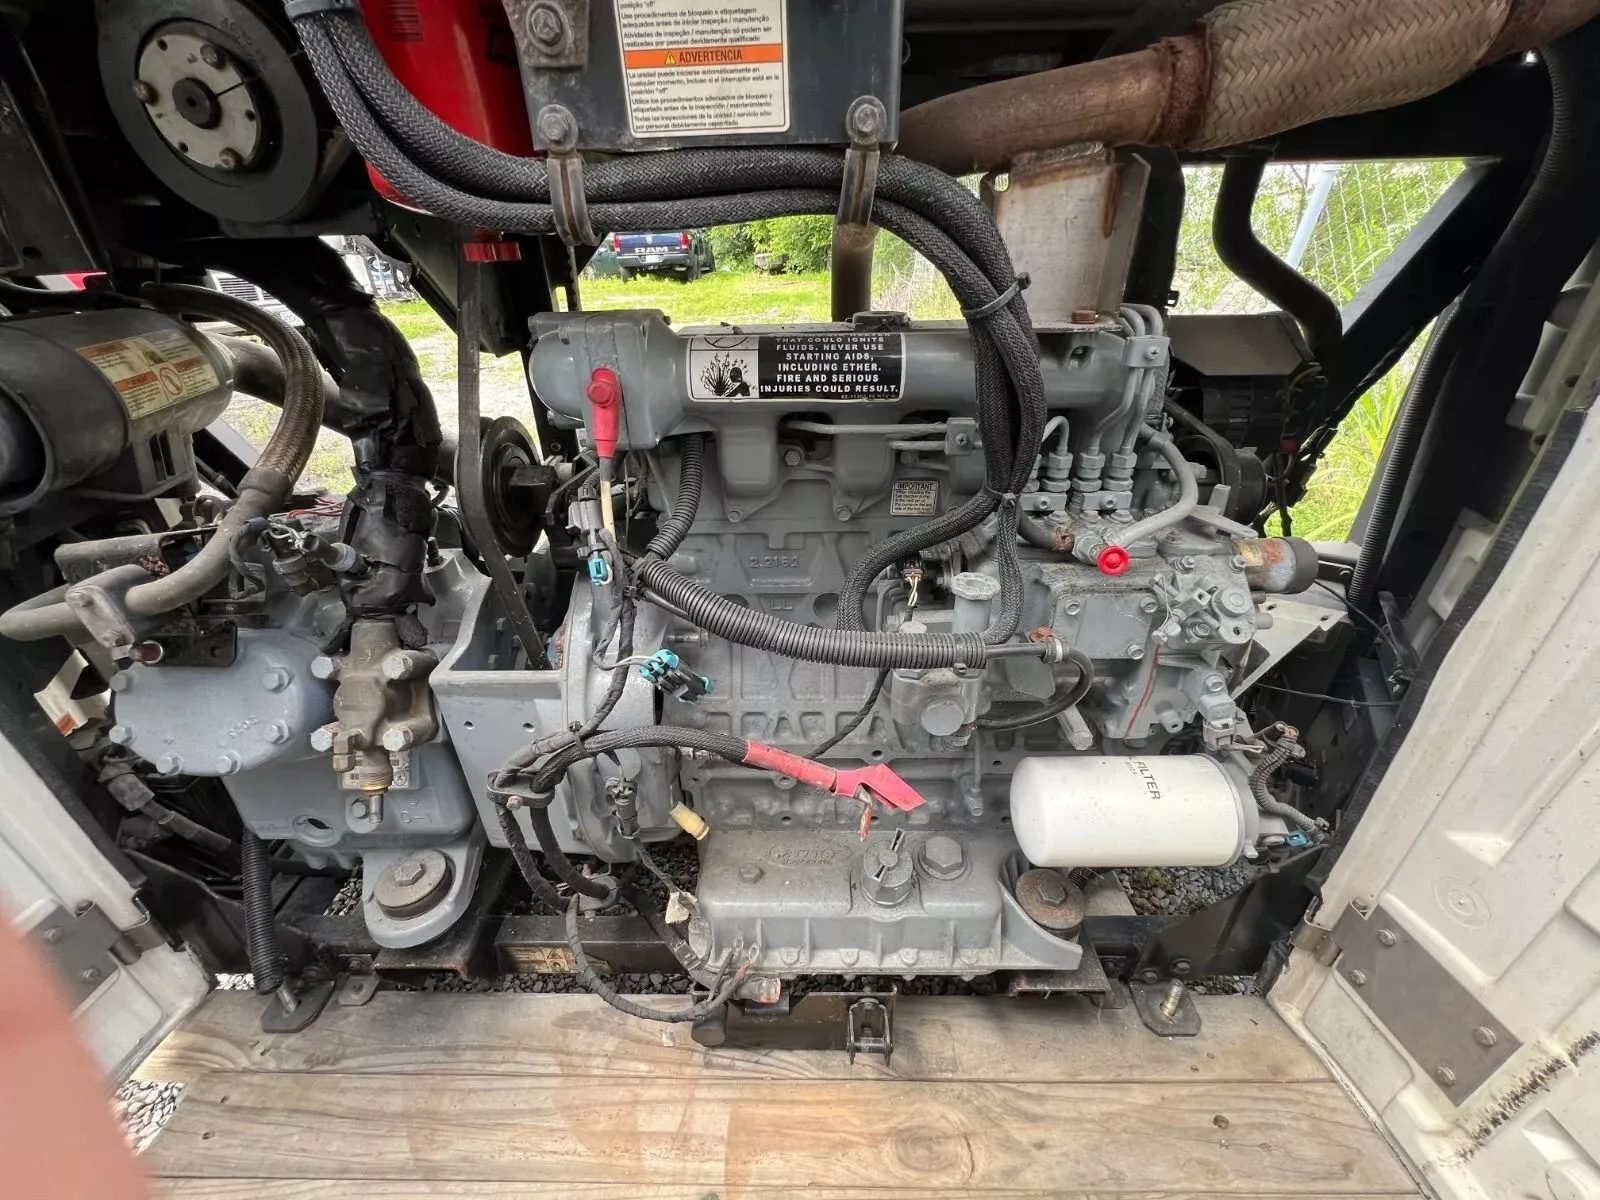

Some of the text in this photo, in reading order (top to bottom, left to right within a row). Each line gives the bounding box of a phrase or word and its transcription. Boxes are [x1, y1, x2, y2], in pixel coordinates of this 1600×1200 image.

[634, 11, 677, 20] procedimentos
[741, 26, 761, 34] podem
[679, 50, 742, 63] ADVERTENCIA
[646, 121, 669, 129] personal
[845, 353, 874, 361] AIDS,
[1132, 761, 1160, 800] FILTER
